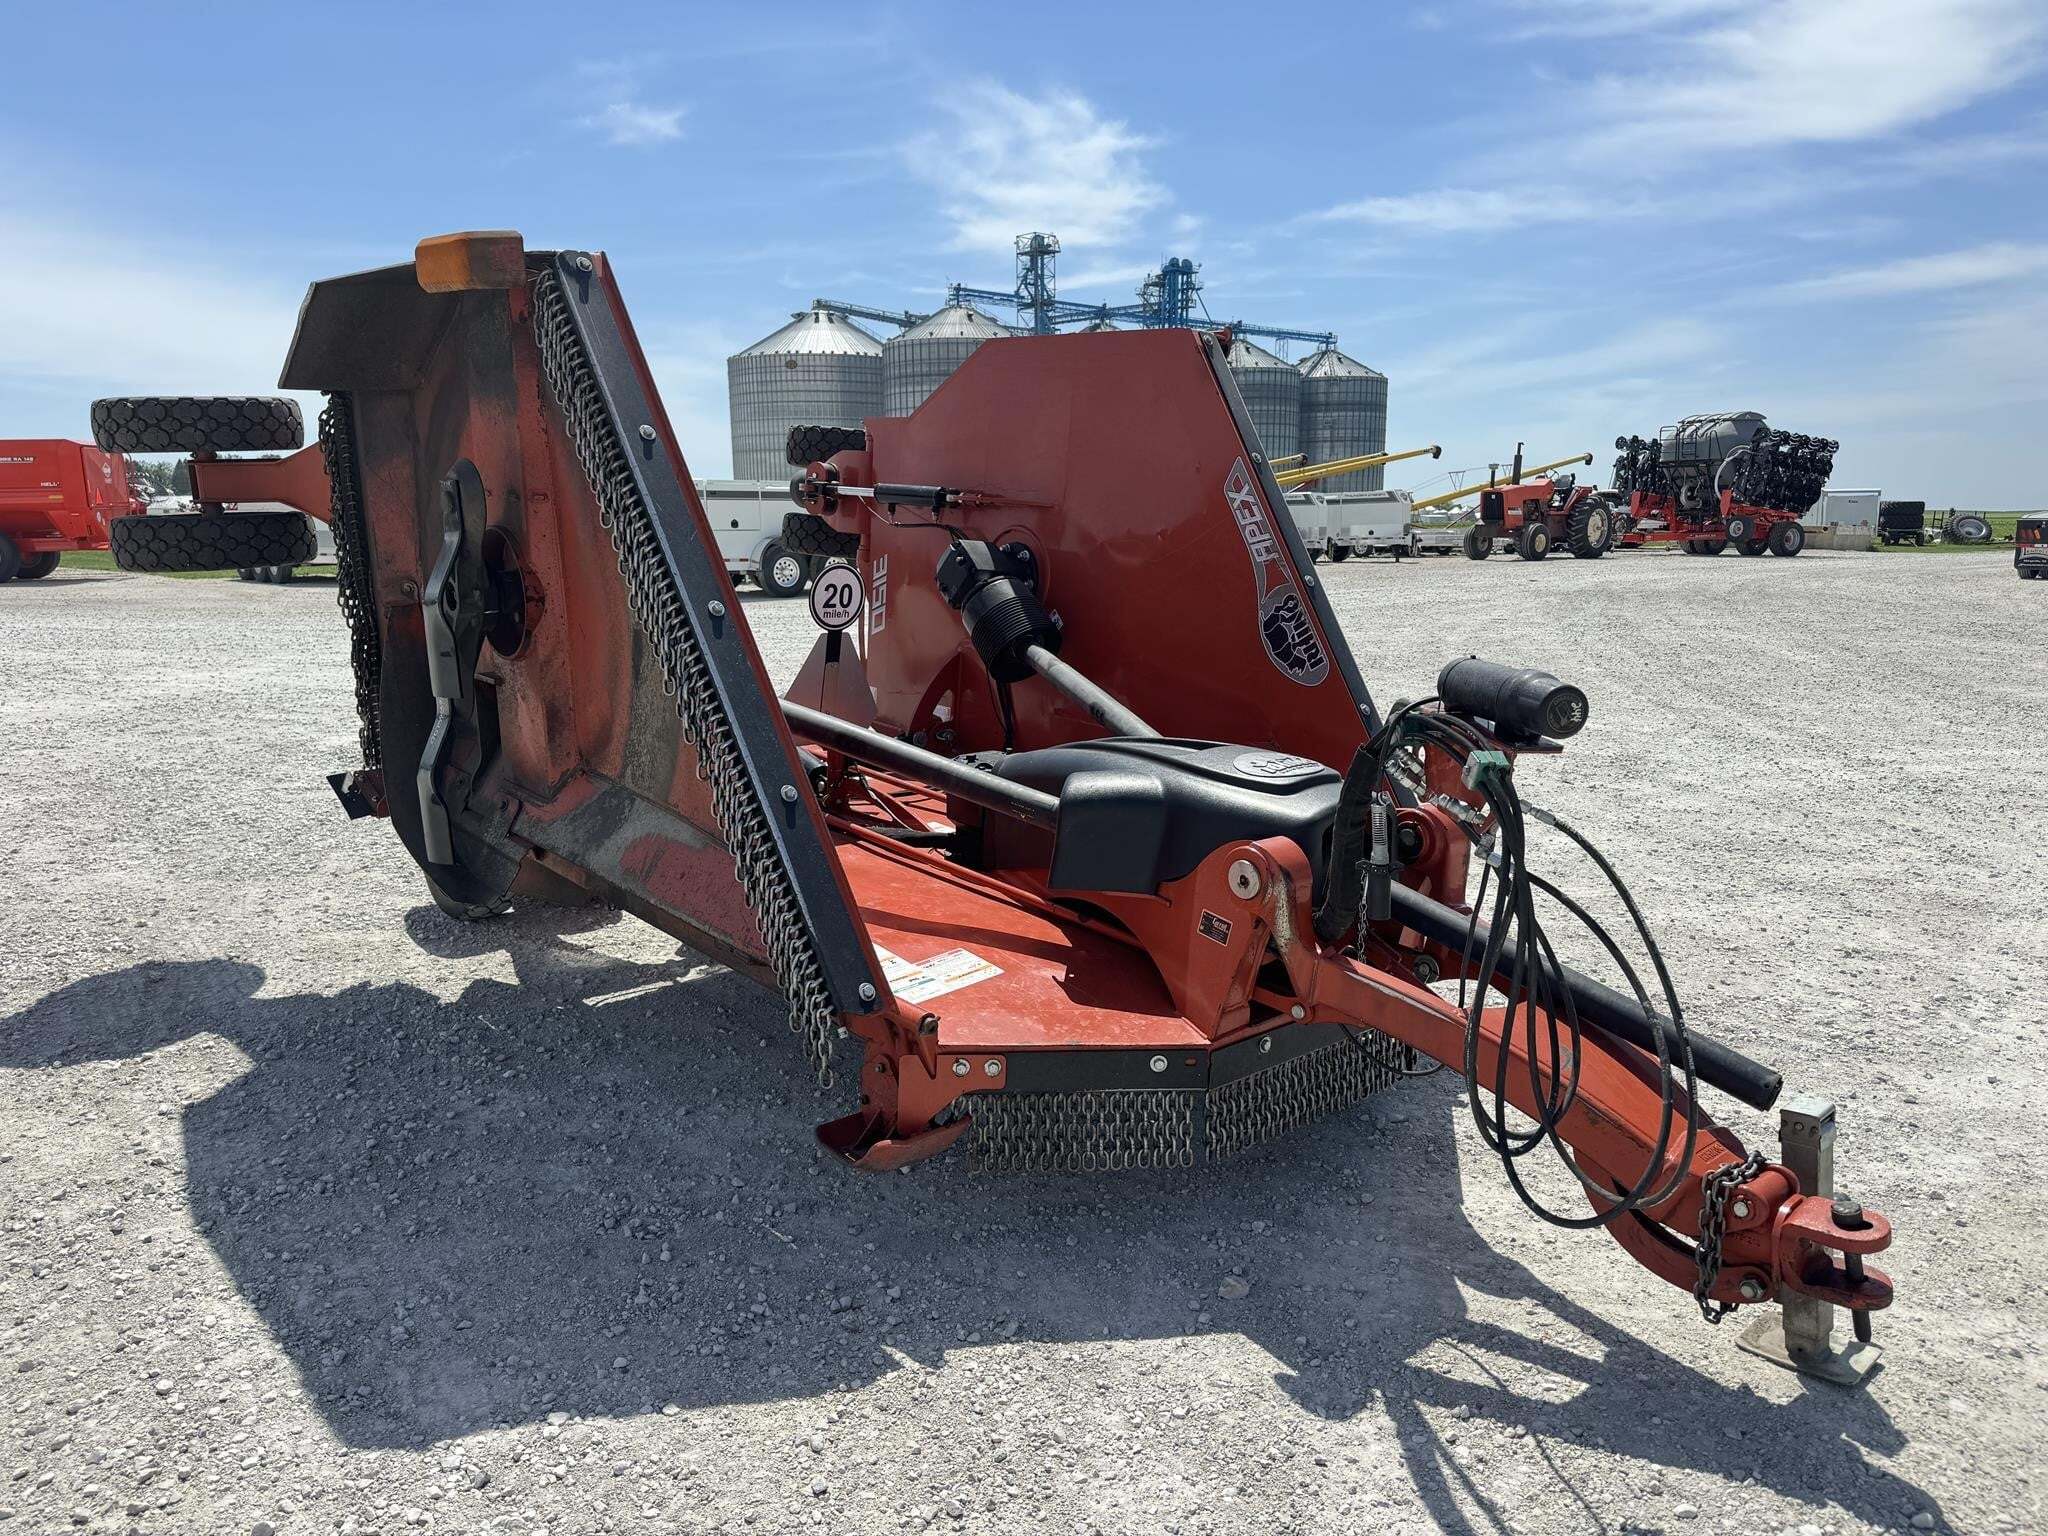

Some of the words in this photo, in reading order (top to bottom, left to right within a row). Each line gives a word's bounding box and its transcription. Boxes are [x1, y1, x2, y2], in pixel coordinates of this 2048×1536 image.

[1227, 482, 1280, 563] APEX
[822, 583, 853, 609] 20
[823, 609, 850, 619] mile/h
[871, 554, 888, 635] 3150
